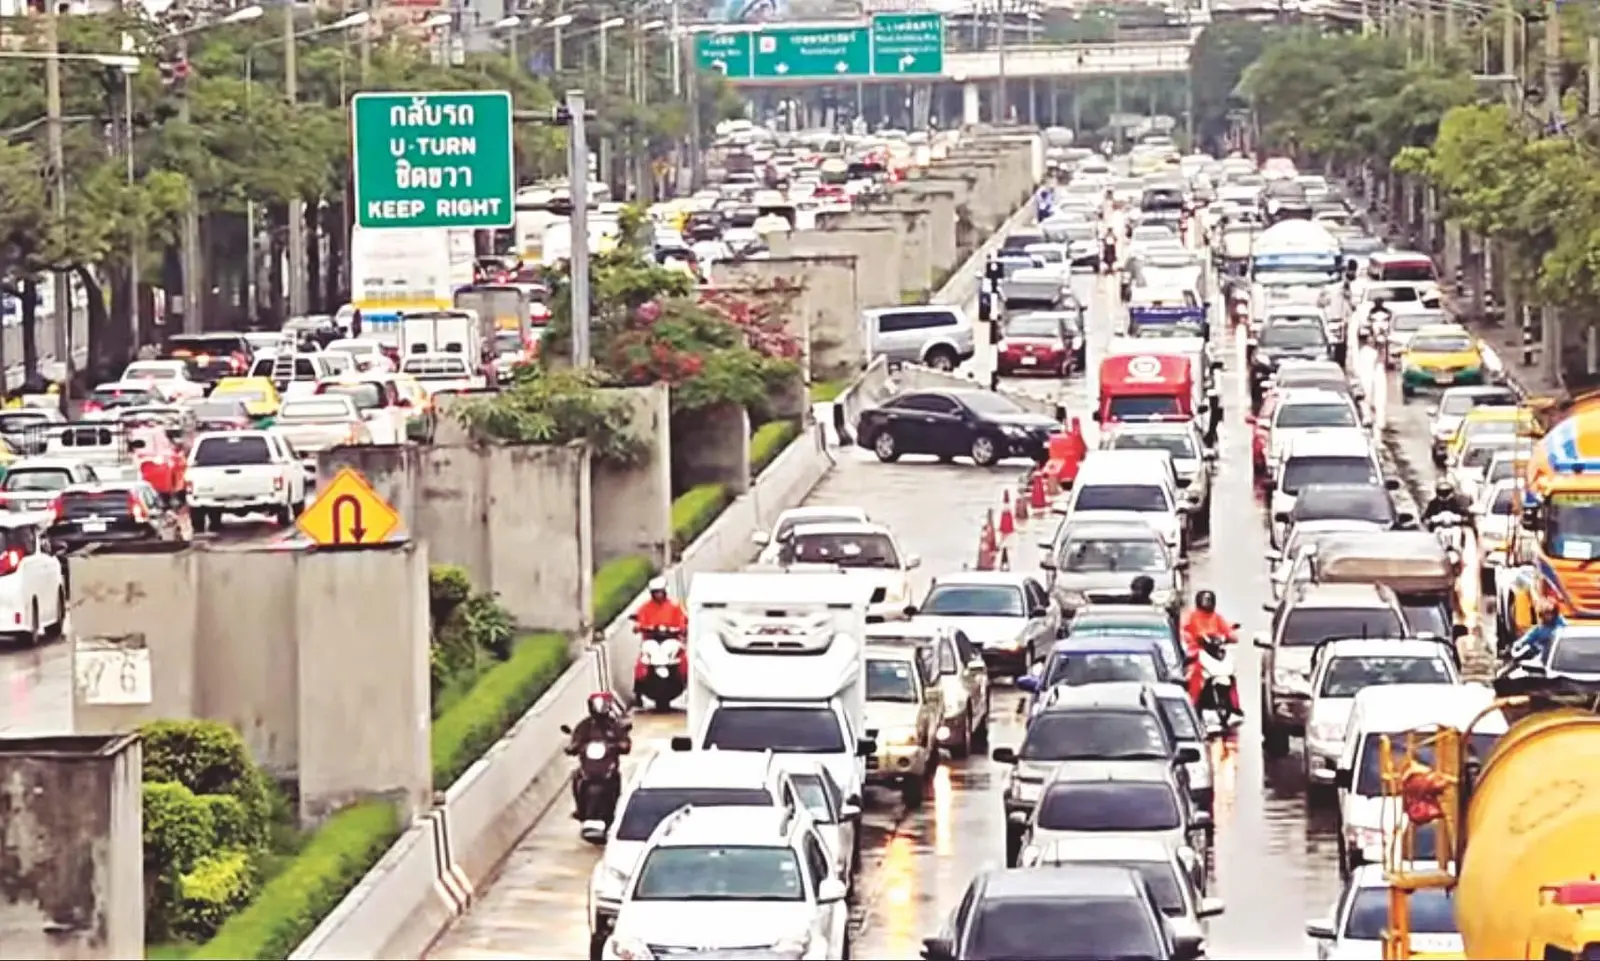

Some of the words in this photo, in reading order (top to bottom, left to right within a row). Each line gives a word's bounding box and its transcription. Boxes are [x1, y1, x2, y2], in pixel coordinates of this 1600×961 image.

[390, 97, 474, 126] กลับรถ
[395, 158, 472, 188] ชิดขวา
[368, 200, 425, 218] KEEP
[436, 198, 502, 217] RIGHT
